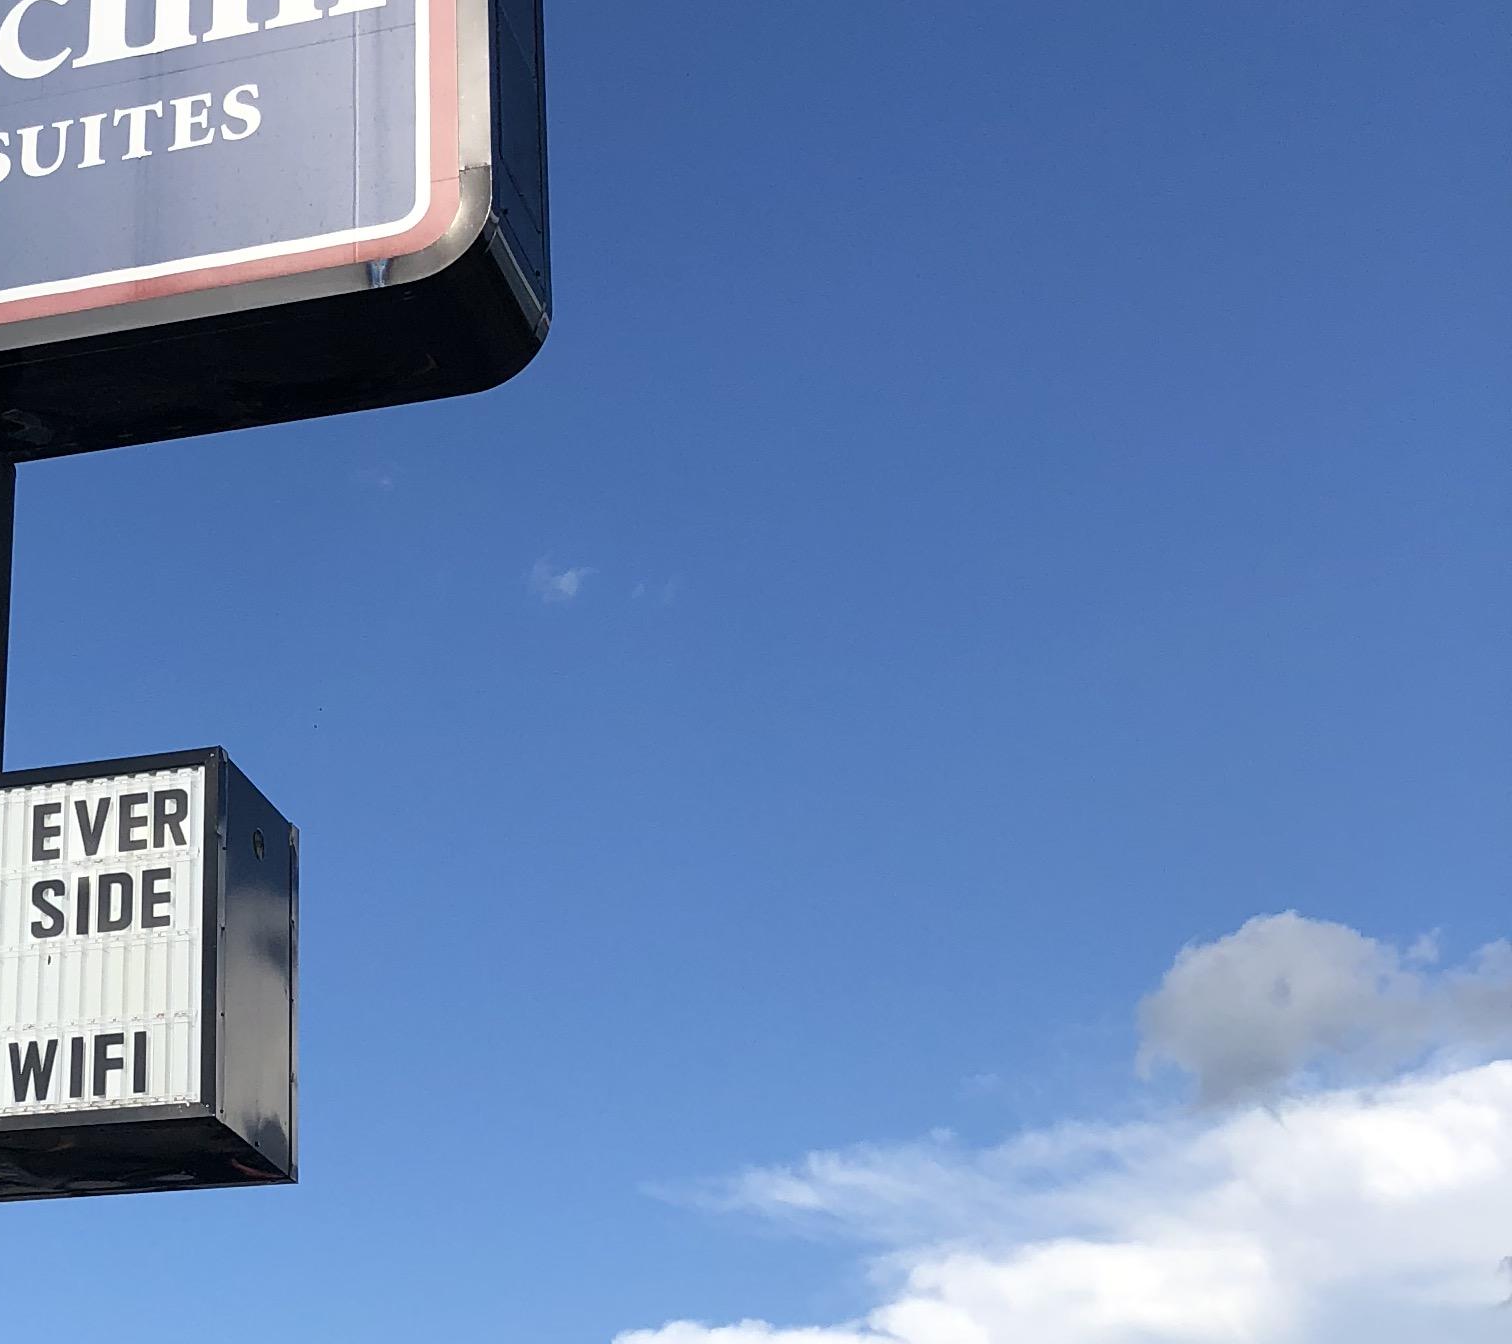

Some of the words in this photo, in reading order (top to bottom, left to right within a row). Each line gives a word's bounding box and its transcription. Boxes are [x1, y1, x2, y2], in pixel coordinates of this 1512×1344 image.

[31, 788, 188, 862] EVER
[30, 867, 172, 939] SIDE
[8, 1030, 147, 1103] WIFI
